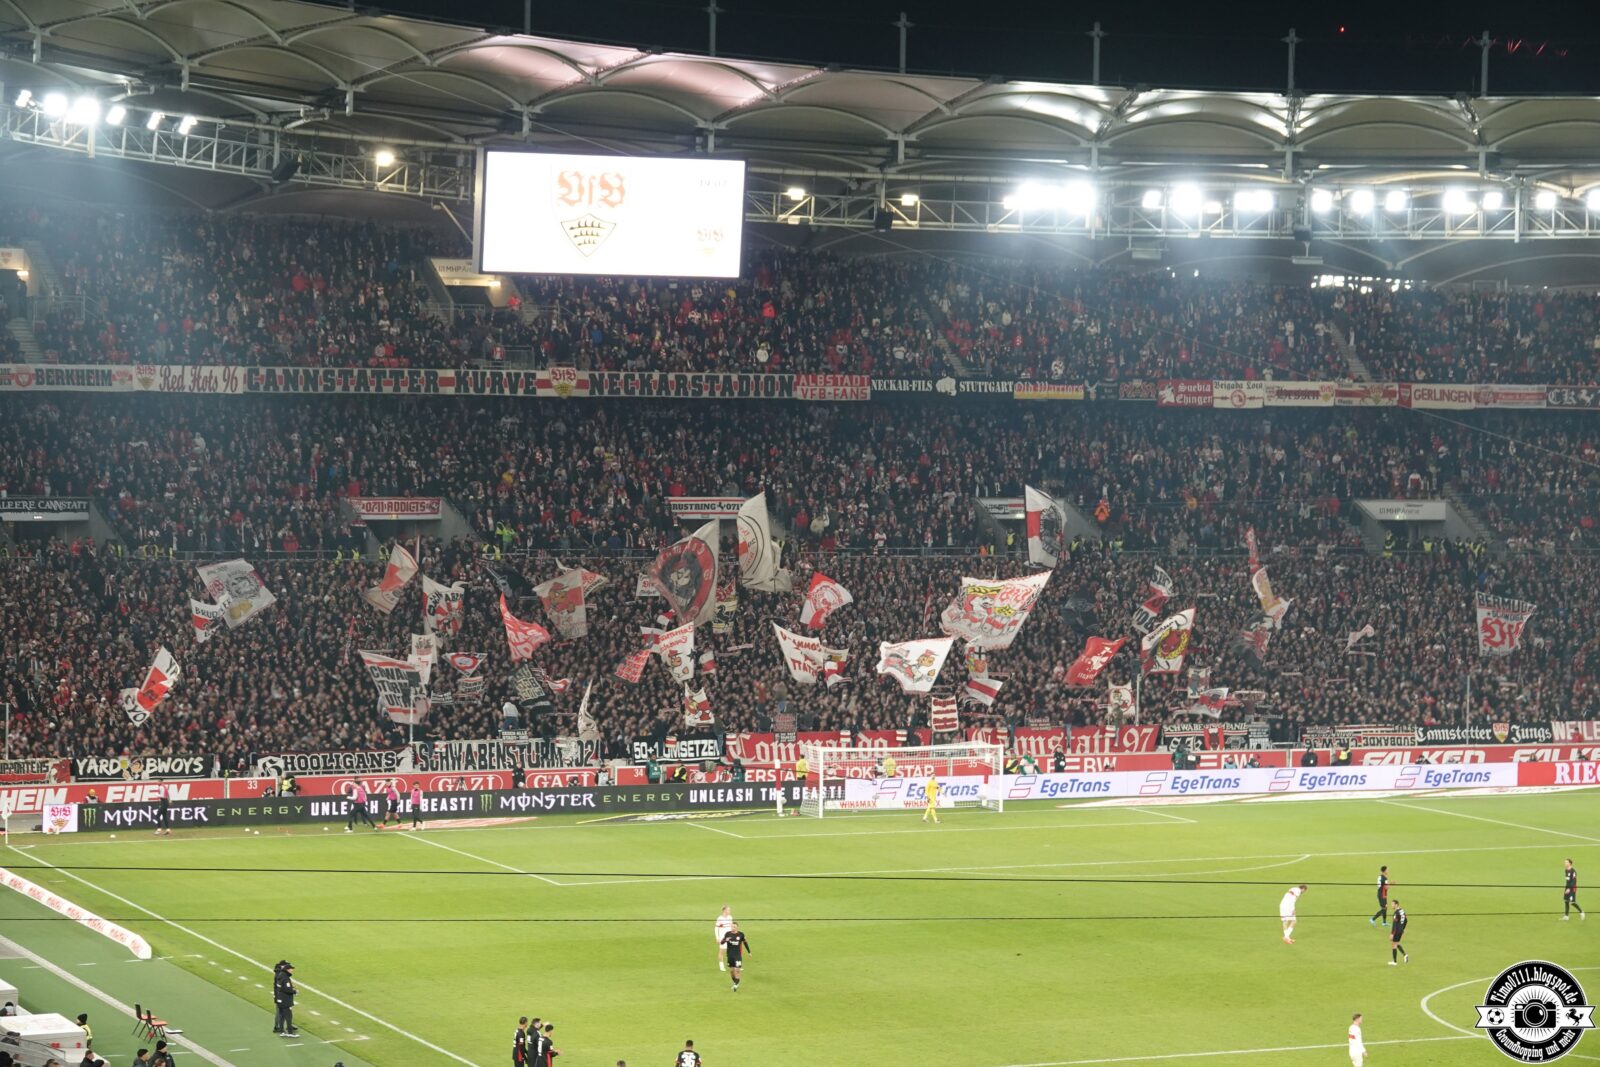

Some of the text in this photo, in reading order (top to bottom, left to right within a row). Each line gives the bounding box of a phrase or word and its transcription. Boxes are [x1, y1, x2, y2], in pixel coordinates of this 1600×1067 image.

[35, 368, 113, 387] BERKHEIM
[160, 365, 186, 391] Red
[222, 366, 239, 393] 96
[247, 367, 794, 397] CANNSTATTER KURVE NECKARSTADION
[801, 375, 870, 386] ALBSTADT
[871, 379, 1014, 393] NECKAR-FILS STUTTGART
[801, 387, 868, 399] VFB-FANS
[1413, 388, 1472, 403] GERLINGEN
[0, 500, 88, 511] LEERE CANNSTATT
[387, 501, 425, 512] ADDICTS
[1122, 727, 1155, 753] 97
[1416, 726, 1492, 742] Cannstatter
[1511, 724, 1552, 743] Jungs
[633, 742, 660, 759] 50+1
[76, 756, 205, 776] YARD BWOYS
[281, 752, 398, 772] HOOLIGANS
[633, 768, 644, 778] 34
[1299, 771, 1367, 790] EgeTrans
[1425, 769, 1492, 787] EgeTrans
[247, 780, 258, 790] 33
[1040, 779, 1111, 797] EgeTrans
[1170, 775, 1241, 794] EgeTrans
[603, 793, 684, 803] ENERGY
[690, 788, 753, 803] UNLEASH
[216, 805, 304, 817] ENERGY
[420, 797, 474, 812] BEAST!
